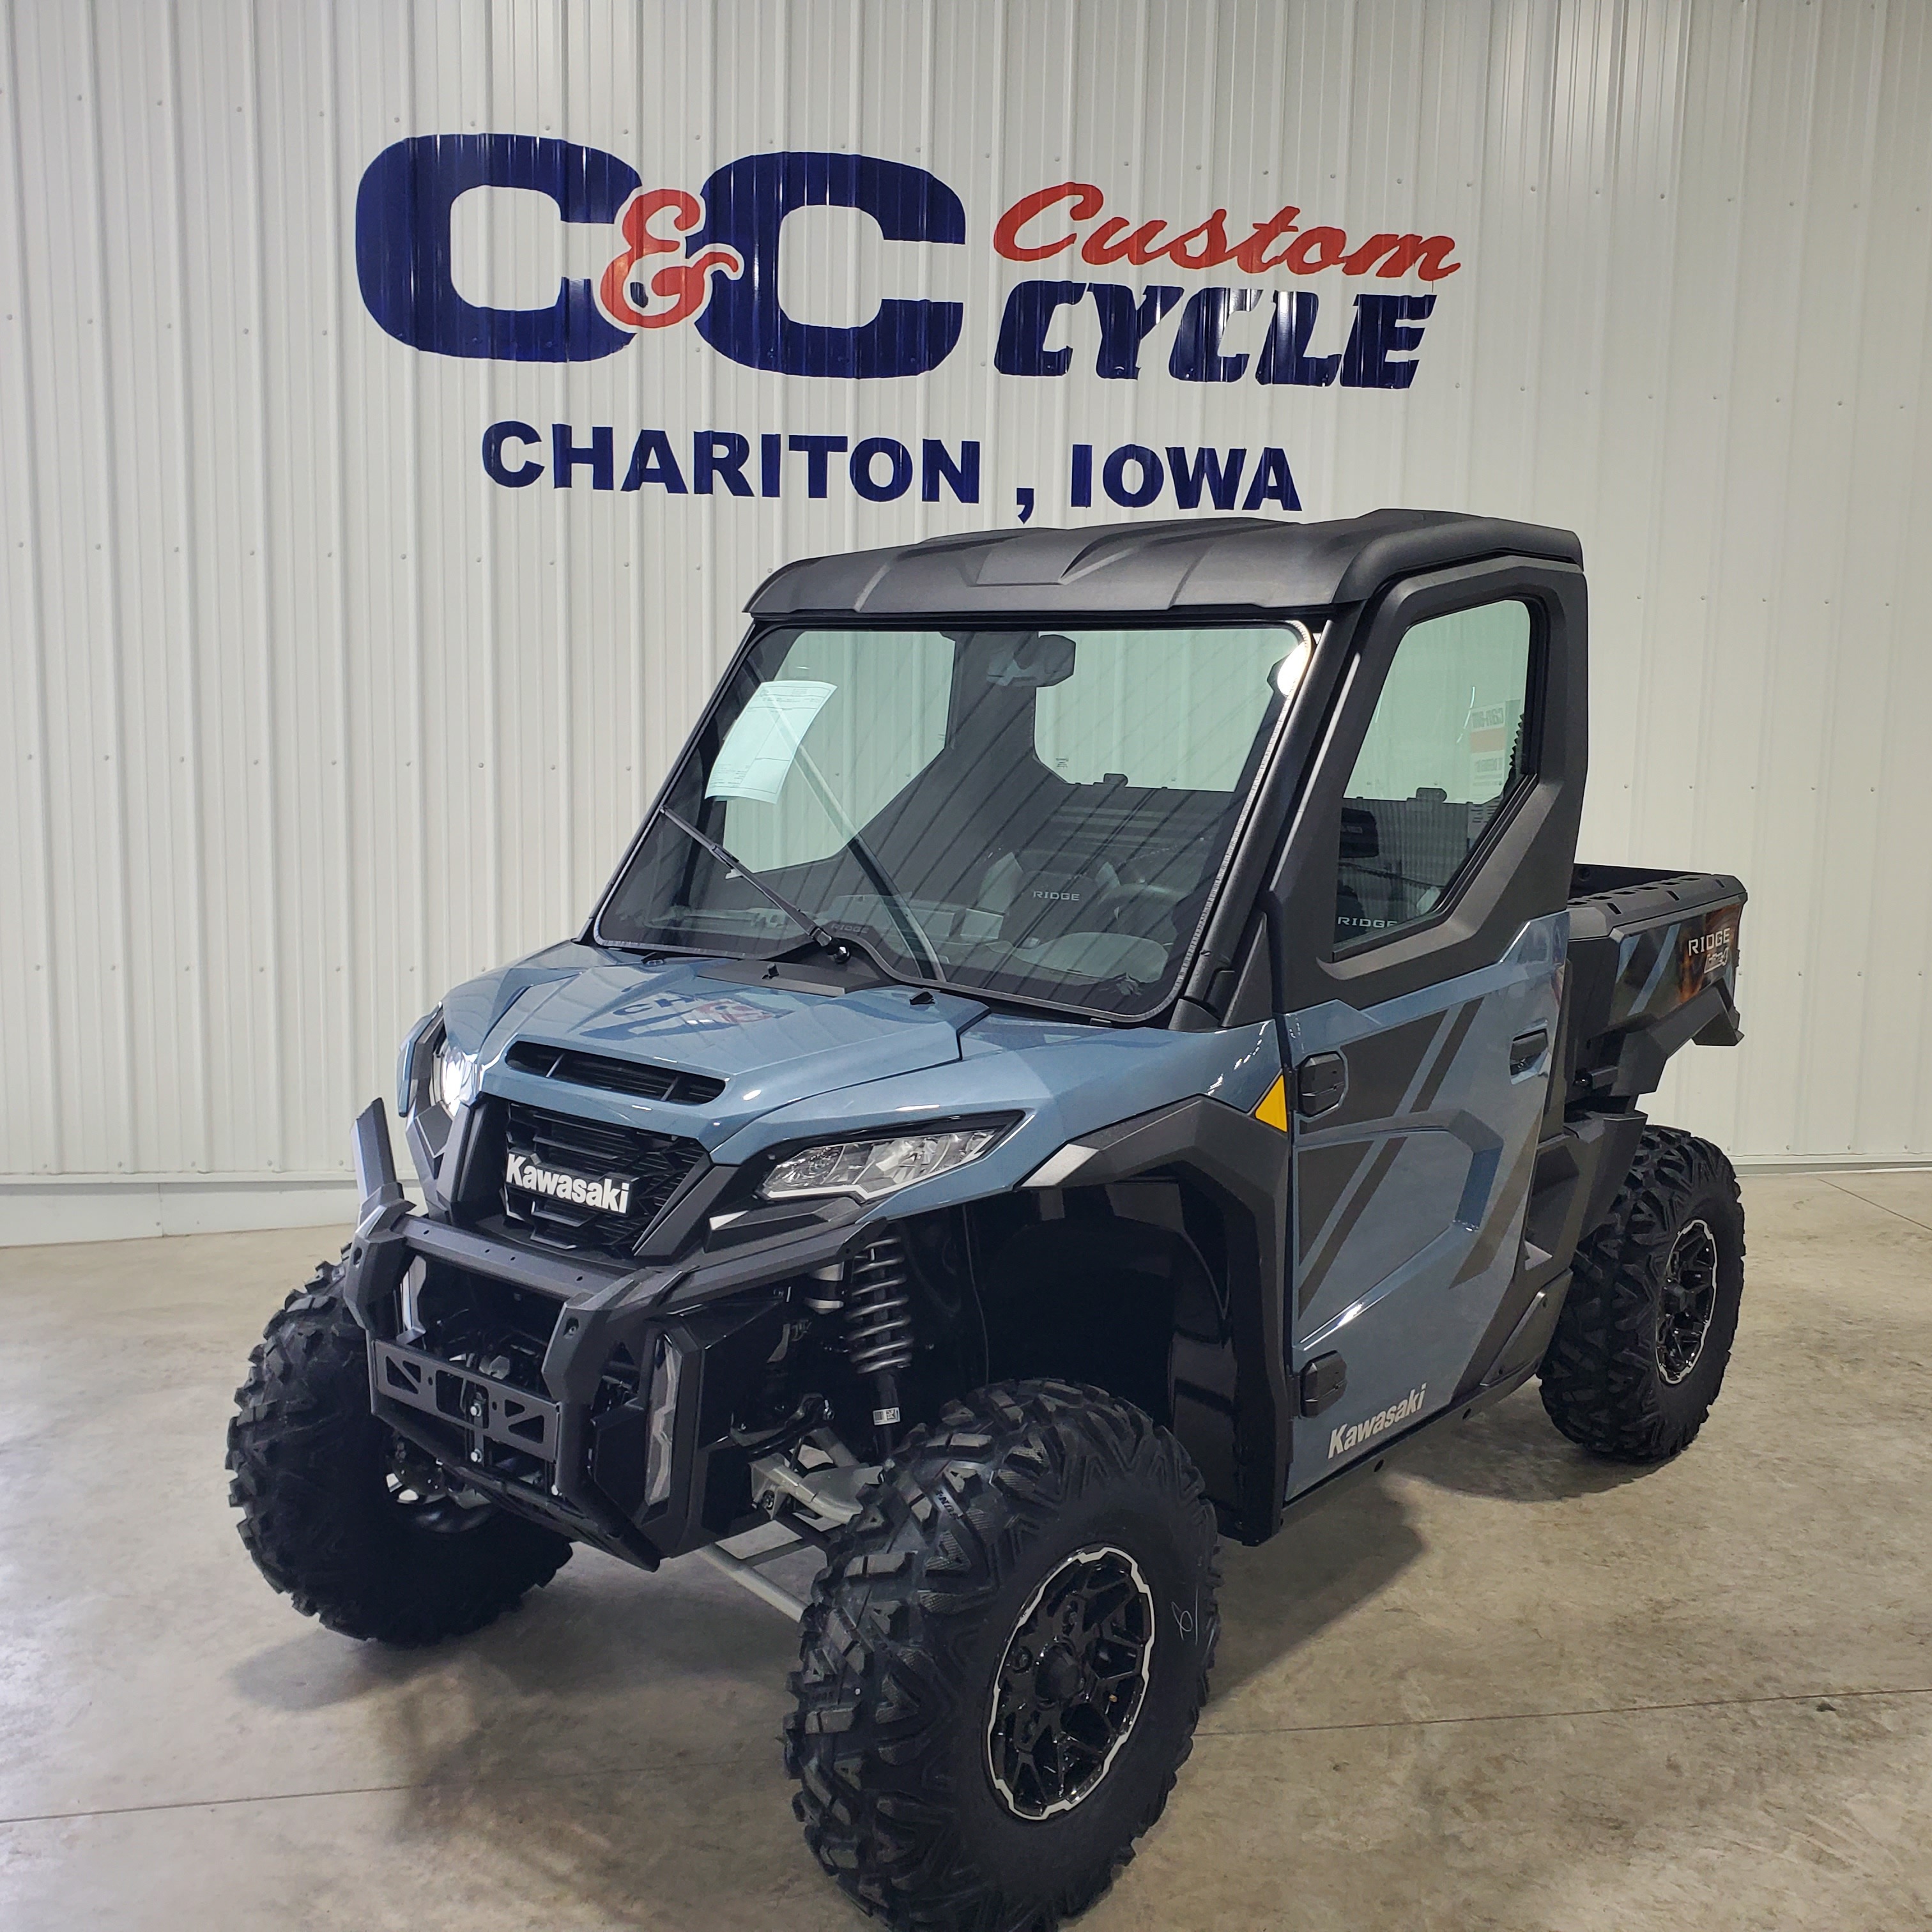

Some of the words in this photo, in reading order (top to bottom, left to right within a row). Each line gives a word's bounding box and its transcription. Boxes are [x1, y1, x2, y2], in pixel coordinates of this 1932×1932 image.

[355, 133, 966, 379] C&C
[993, 181, 1461, 282] Custom
[993, 280, 1438, 389] CYCLE
[482, 420, 980, 504] CHARITON
[1071, 443, 1303, 512] IOWA
[1033, 891, 1080, 901] RIDGE
[1688, 927, 1731, 956] RIDGE
[505, 1153, 630, 1214] Kawasaki
[1328, 1382, 1427, 1460] Kawasaki
